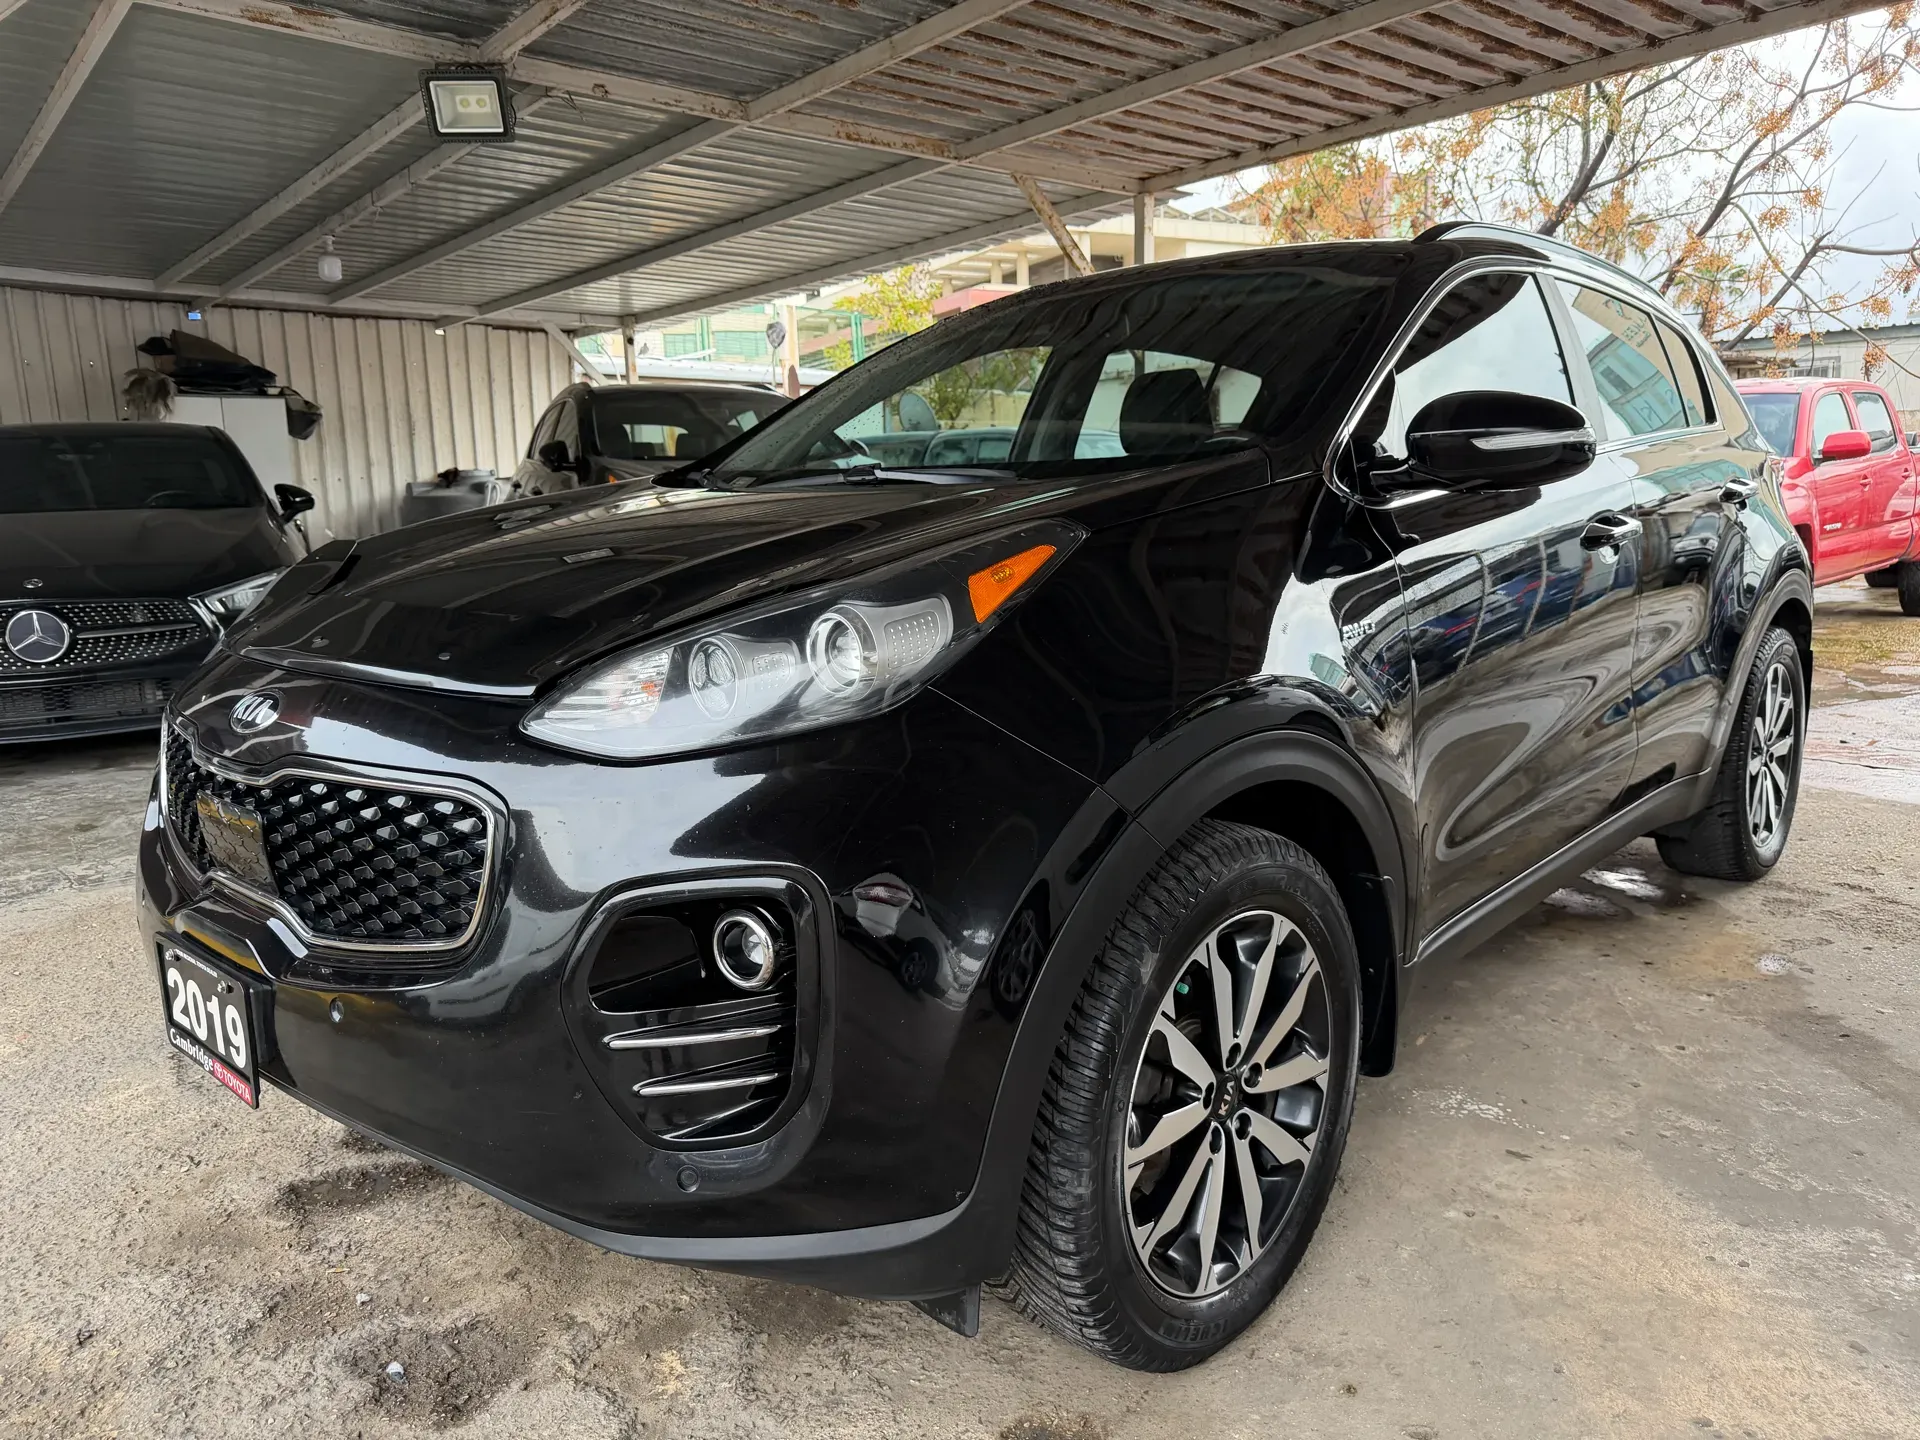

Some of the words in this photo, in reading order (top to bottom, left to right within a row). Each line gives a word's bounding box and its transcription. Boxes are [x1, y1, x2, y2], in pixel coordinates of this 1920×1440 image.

[1342, 620, 1375, 640] AWD
[233, 696, 273, 724] KIA
[167, 967, 246, 1069] 2019
[170, 1028, 213, 1071] Cambridge
[222, 1069, 251, 1101] TOYOTA
[1218, 1081, 1235, 1116] KIA
